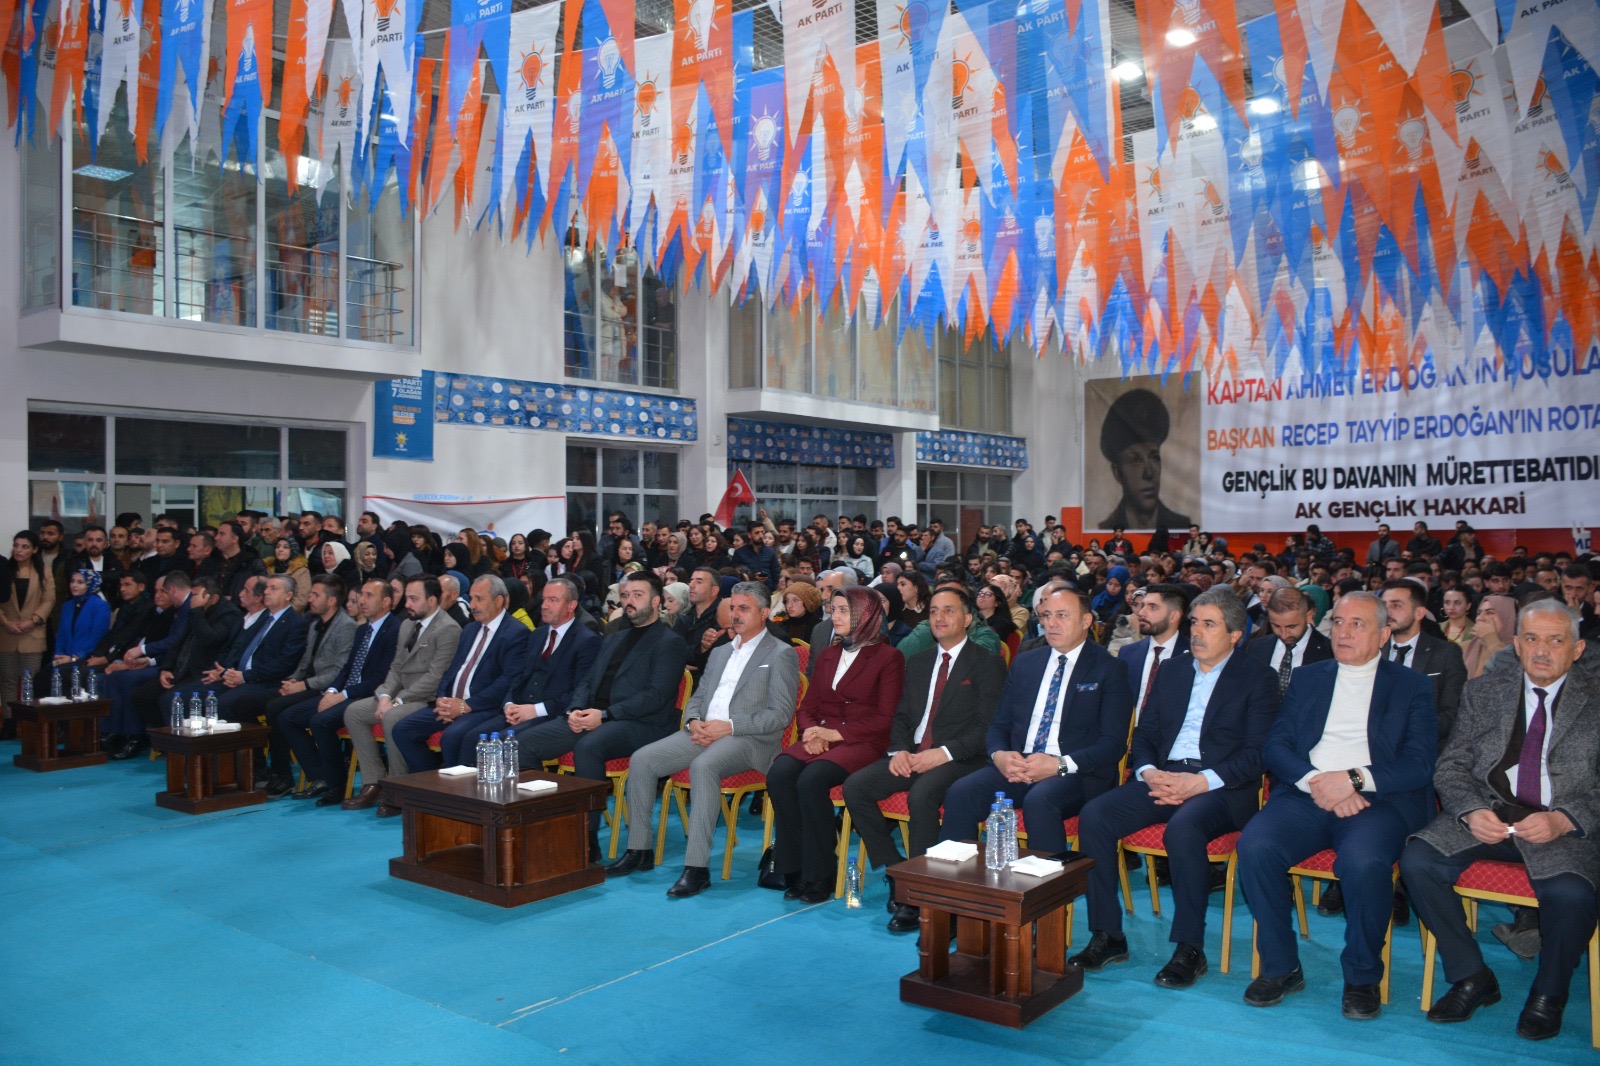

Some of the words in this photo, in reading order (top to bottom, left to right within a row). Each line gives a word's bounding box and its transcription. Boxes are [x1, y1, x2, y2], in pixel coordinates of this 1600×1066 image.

[1521, 5, 1537, 18] AK
[797, 16, 812, 28] AK
[1017, 21, 1032, 35] AK
[1037, 11, 1066, 28] PART
[681, 55, 696, 67] AK
[1378, 62, 1393, 72] AK
[895, 62, 909, 74] AK
[1563, 67, 1581, 79] AK
[591, 93, 602, 104] AK
[1047, 87, 1060, 98] AK
[514, 104, 525, 113] AK
[526, 101, 545, 112] PARTi
[1514, 122, 1530, 133] AK
[1532, 115, 1558, 128] PART
[632, 131, 640, 139] AK
[1074, 154, 1085, 163] AK
[669, 167, 679, 175] AK
[680, 165, 695, 174] PART
[747, 163, 759, 172] AK
[1208, 376, 1282, 405] KAPTAN
[1286, 371, 1357, 400] AHMET
[1207, 426, 1275, 456] BAŞKAN
[1282, 422, 1339, 447] RECEP
[1346, 412, 1410, 443] TAYYİP
[1414, 405, 1542, 439] ERDOĞAN'IN
[1548, 403, 1600, 431] ROTA
[1223, 464, 1297, 498] GENÇLİK
[1303, 467, 1328, 490] BU
[1333, 464, 1417, 490] DAVANIN
[1295, 502, 1322, 519] AK
[1328, 496, 1417, 522] GENÇLİK
[1424, 491, 1526, 516] HAKKARİ
